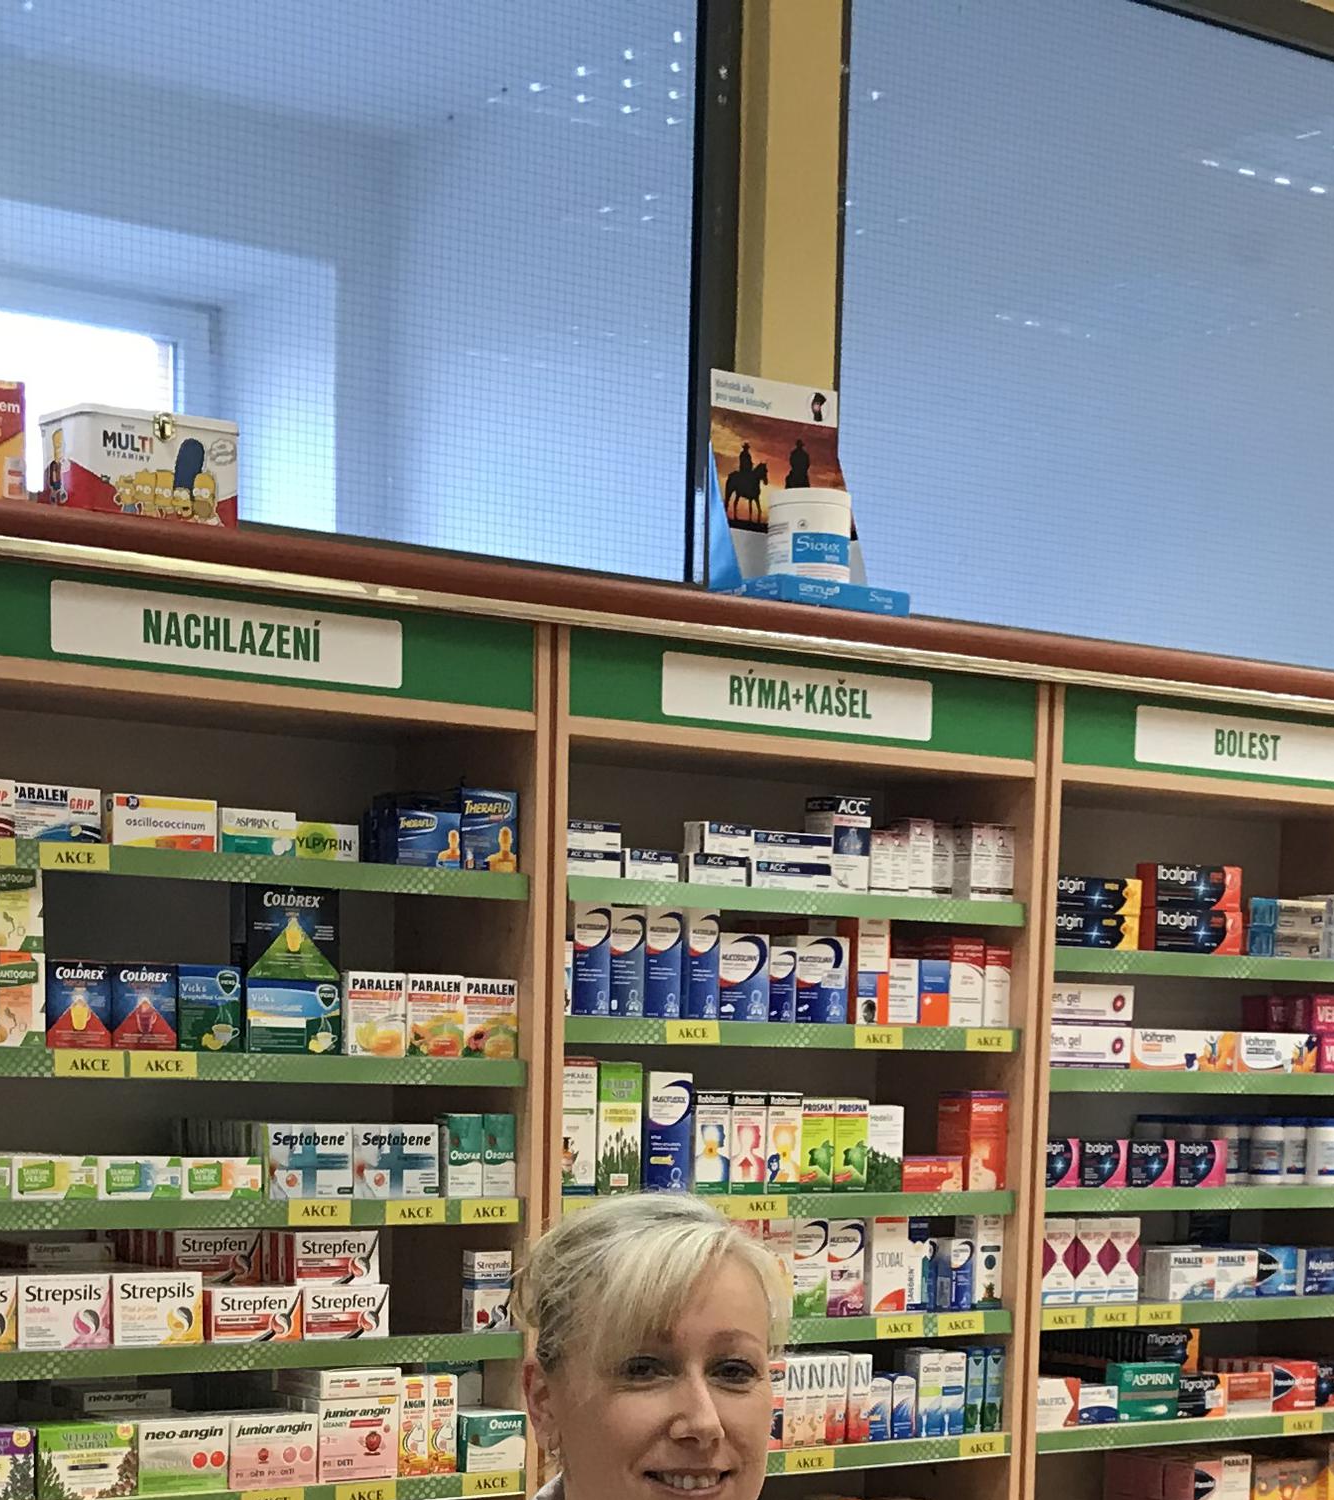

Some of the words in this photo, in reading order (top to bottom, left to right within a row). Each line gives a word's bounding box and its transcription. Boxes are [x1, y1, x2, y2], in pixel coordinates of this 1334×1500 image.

[102, 430, 154, 455] MULTI
[142, 607, 322, 663] NACHLAZENÍ
[728, 668, 874, 721] RÝMA+KAŠEL
[1214, 728, 1282, 763] BOLEST
[69, 797, 95, 812] GRIP
[463, 799, 512, 816] THERAFLU
[838, 799, 868, 815] ACC
[125, 816, 207, 833] oscillococcinum
[234, 816, 267, 830] ASPIRIN
[55, 850, 96, 865] AKCE
[1157, 864, 1198, 883] Ibalgin
[263, 889, 323, 909] COLDREX
[1157, 910, 1198, 929] Ibalgin
[55, 965, 106, 981] COLDREX
[119, 967, 171, 983] COLDREX
[352, 977, 404, 992] PARALEN
[411, 980, 461, 995] PARALEN
[466, 982, 515, 997] PARALEN
[678, 1027, 709, 1040] AKCE
[865, 1033, 894, 1045] AKCE
[69, 1057, 110, 1073] AKCE
[144, 1057, 184, 1072] AKCE
[803, 1103, 833, 1114] PROSPAN
[839, 1102, 868, 1114] PROSPAN
[272, 1131, 348, 1150] Septabene
[361, 1131, 434, 1150] Septabene
[301, 1204, 338, 1218] AKCE
[399, 1206, 434, 1219] AKCE
[473, 1205, 507, 1219] AKCE
[181, 1236, 248, 1255] Strepfen
[302, 1239, 366, 1258] Strepfen
[876, 1250, 904, 1269] STODAL
[25, 1284, 103, 1306] Strepsils
[119, 1282, 195, 1304] Strepsils
[220, 1294, 288, 1313] Strepfen
[311, 1293, 376, 1313] Strepfen
[886, 1322, 913, 1334] AKCE
[948, 1318, 975, 1331] AKCE
[1132, 1372, 1174, 1387] ASPIRIN
[796, 1457, 824, 1469] AKCE
